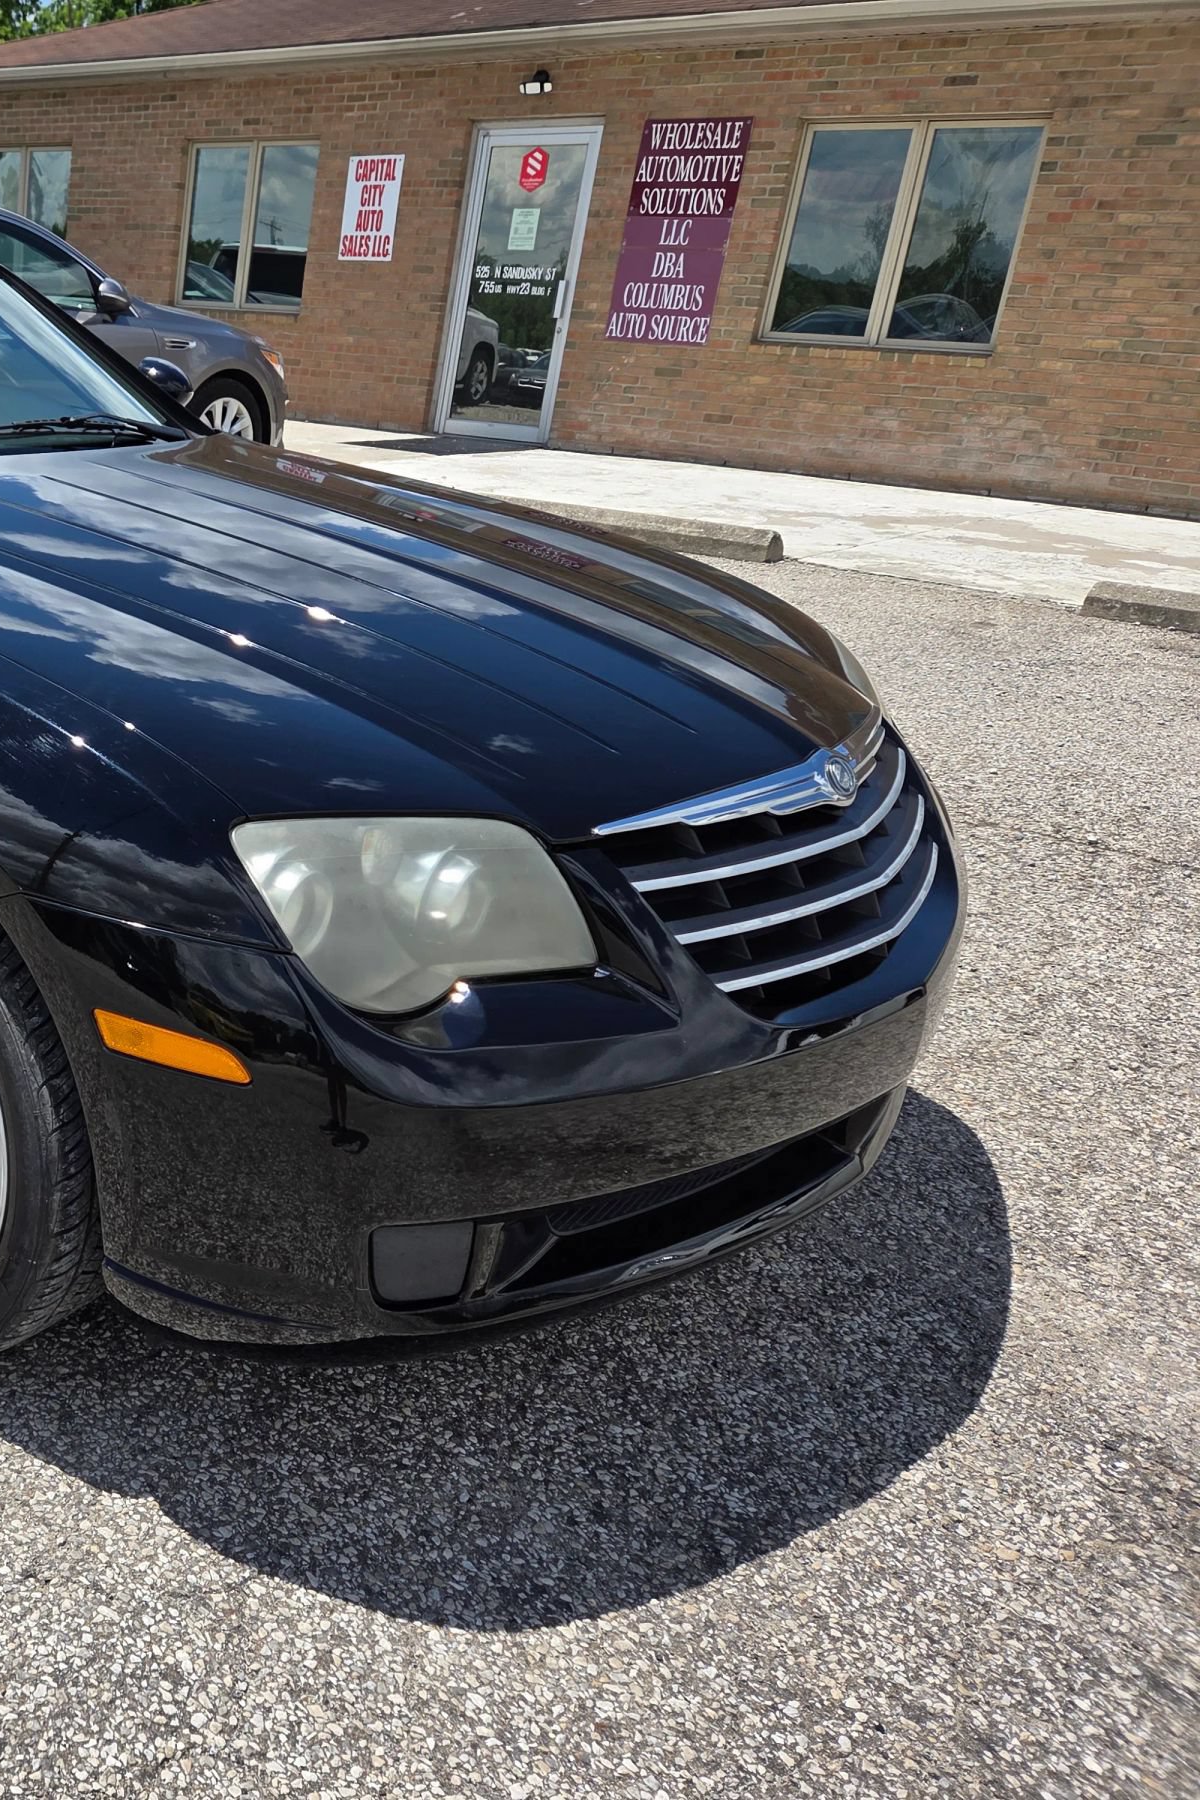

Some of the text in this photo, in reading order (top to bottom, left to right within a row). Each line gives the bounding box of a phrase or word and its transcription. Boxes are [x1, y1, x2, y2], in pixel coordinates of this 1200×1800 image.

[651, 121, 744, 150] WHOLESALE
[355, 158, 397, 182] CAPITAL
[635, 155, 743, 183] AUTOMOTIVE
[360, 184, 385, 207] CITY
[639, 188, 726, 215] SOLUTIONS
[355, 209, 383, 232] AUTO
[658, 219, 692, 246] LLC
[341, 234, 390, 257] SALES LLC
[475, 266, 557, 281] 525 N SANDUSKY ST
[651, 252, 685, 279] DBA
[531, 286, 545, 296] BLDG
[547, 287, 552, 296] F
[623, 282, 704, 311] COLUMBUS
[606, 312, 710, 344] AUTO SOURCE
